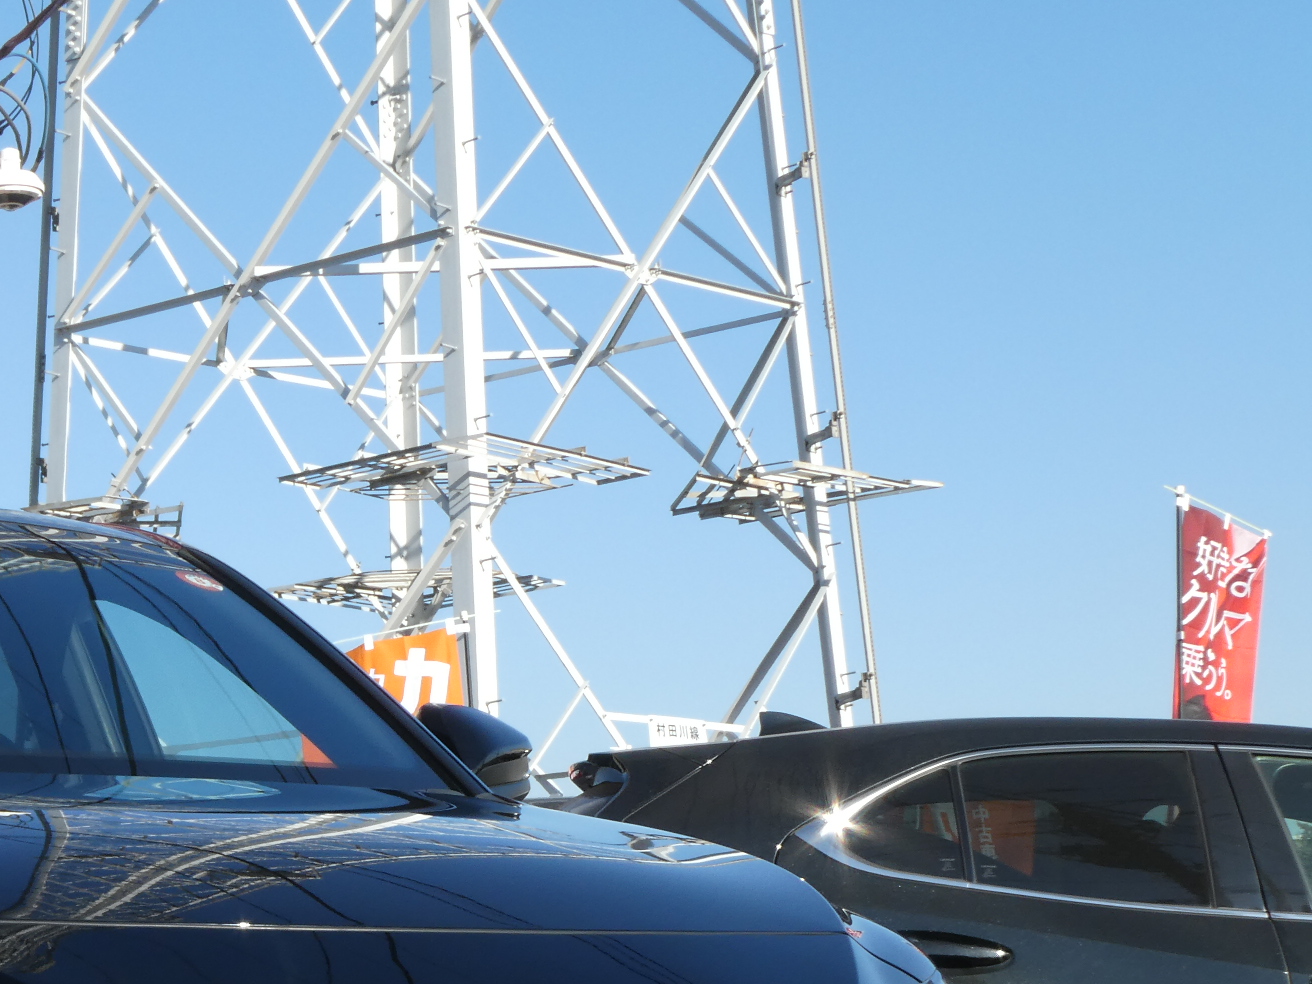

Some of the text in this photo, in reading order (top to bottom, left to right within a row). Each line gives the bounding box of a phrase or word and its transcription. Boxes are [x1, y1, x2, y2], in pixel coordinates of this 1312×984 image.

[1193, 535, 1257, 598] 好きな
[1181, 578, 1253, 650] クルマ
[656, 722, 700, 741] 村田川線
